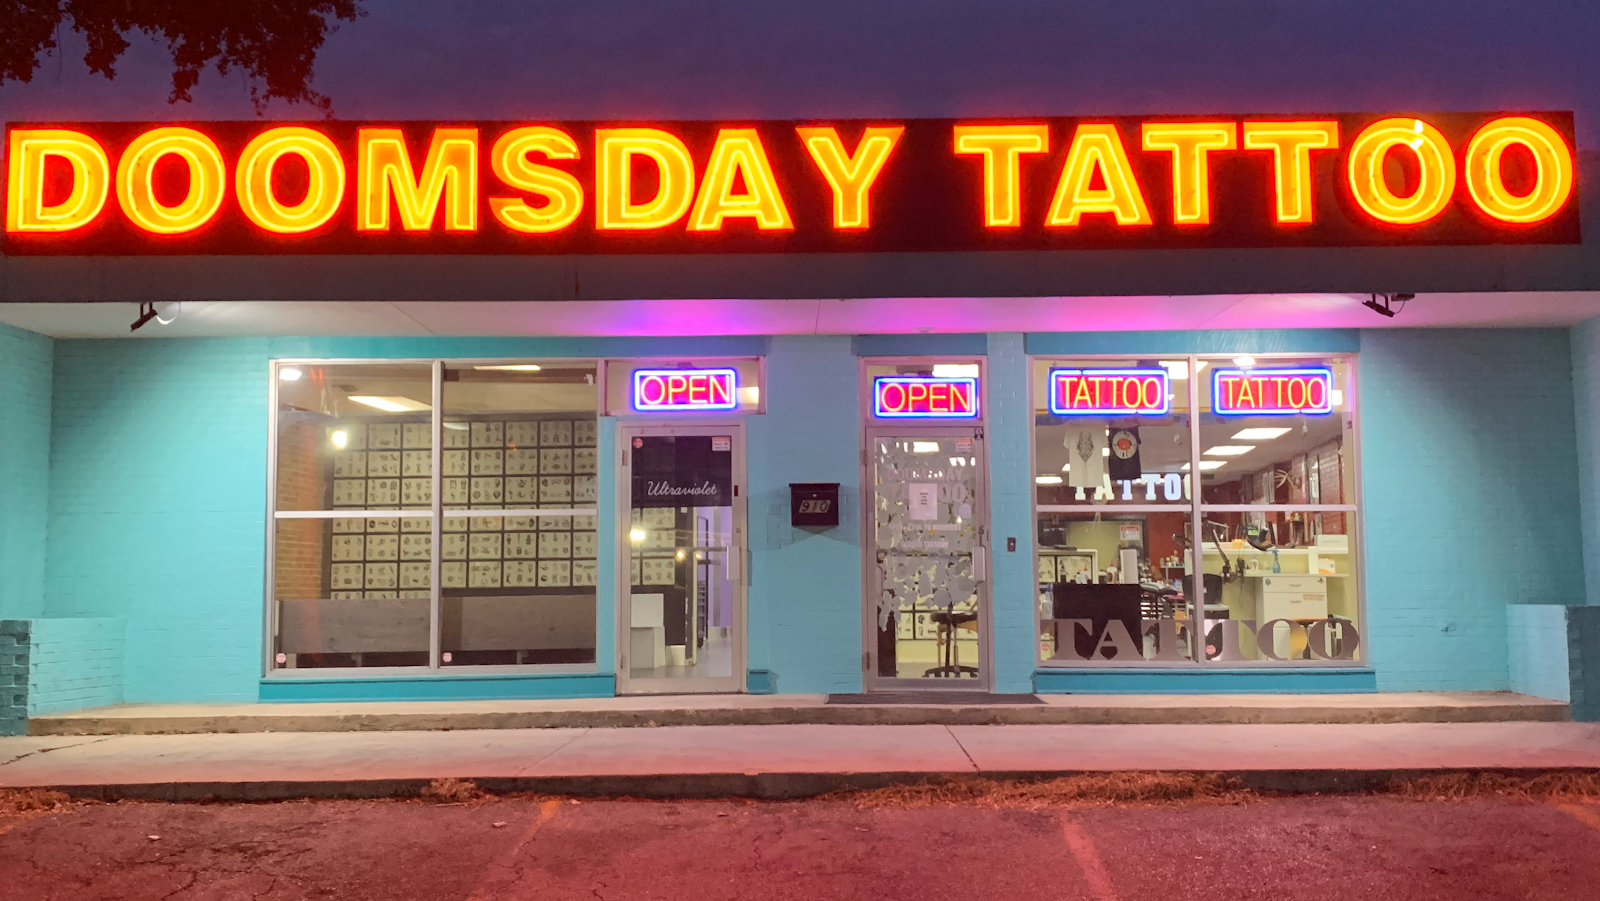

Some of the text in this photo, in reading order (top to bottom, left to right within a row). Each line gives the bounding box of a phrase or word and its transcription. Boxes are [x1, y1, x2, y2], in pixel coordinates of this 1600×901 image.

[6, 117, 1573, 233] DOOMSDAY TATTOO
[641, 375, 732, 405] OPEN
[881, 382, 970, 412] OPEN
[1058, 376, 1161, 409] TATTOO
[1221, 376, 1325, 409] TATTOO
[647, 480, 717, 496] Ultraviolet
[801, 501, 828, 513] 910
[1040, 619, 1360, 661] TATTOO
